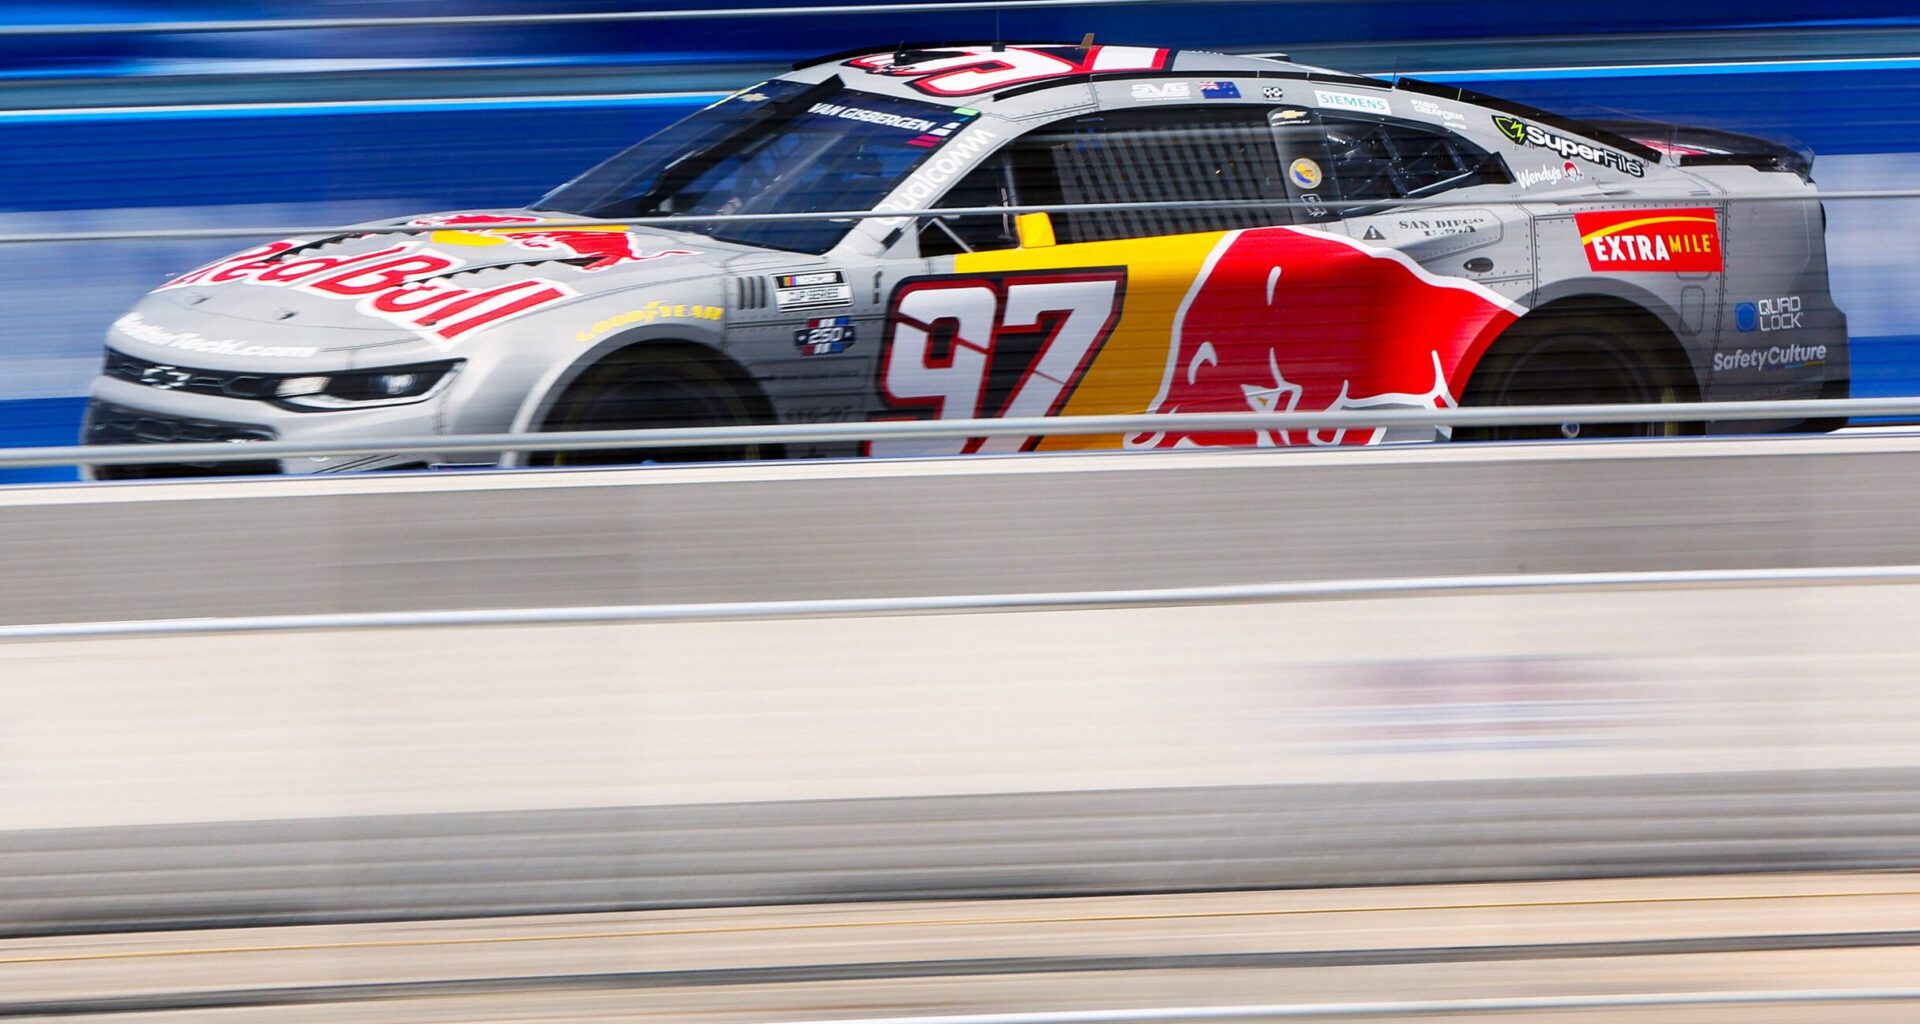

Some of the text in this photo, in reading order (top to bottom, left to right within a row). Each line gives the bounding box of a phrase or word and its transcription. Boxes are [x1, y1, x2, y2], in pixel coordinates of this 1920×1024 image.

[1320, 94, 1386, 111] SIEMENS
[808, 102, 936, 132] VAN GISBERGEN
[1516, 164, 1562, 189] Wendy's
[1399, 218, 1484, 230] SAN DIEGO
[1758, 296, 1801, 315] QUAD
[1760, 313, 1802, 331] LOCK
[807, 327, 844, 344] 250
[866, 270, 1123, 455] 97
[1713, 344, 1827, 372] SafetyCulture
